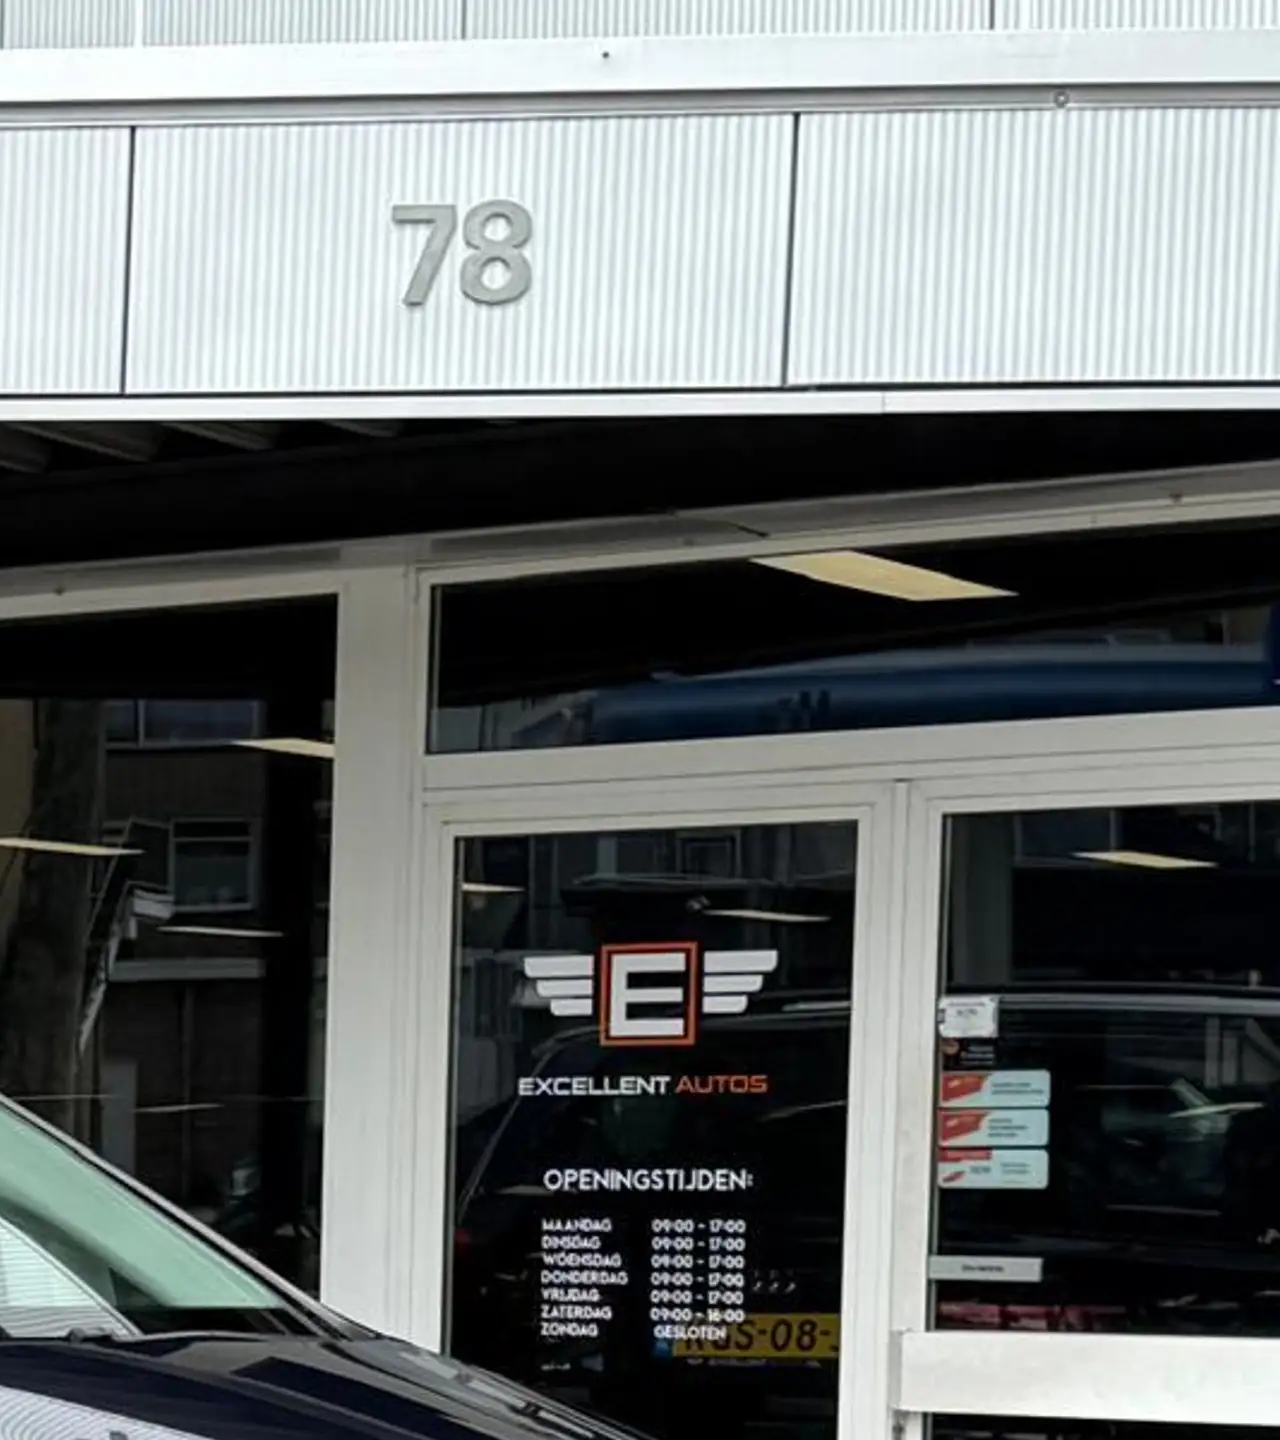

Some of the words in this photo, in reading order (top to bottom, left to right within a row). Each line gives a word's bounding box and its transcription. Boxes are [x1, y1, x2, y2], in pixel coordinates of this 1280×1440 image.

[391, 199, 533, 306] 78
[517, 1075, 671, 1096] EXCELLENT
[676, 1074, 768, 1094] AUTOS
[543, 1168, 754, 1191] OPENINGSTIJDEN:
[541, 1218, 613, 1232] MAANDAG
[541, 1252, 622, 1267] WOENSDAG
[540, 1269, 629, 1285] DONDERDAG
[541, 1287, 601, 1302] VRIJDAG
[540, 1304, 613, 1320] ZATERDAG
[540, 1321, 599, 1337] ZONDAG
[653, 1324, 728, 1340] GESLOTEN
